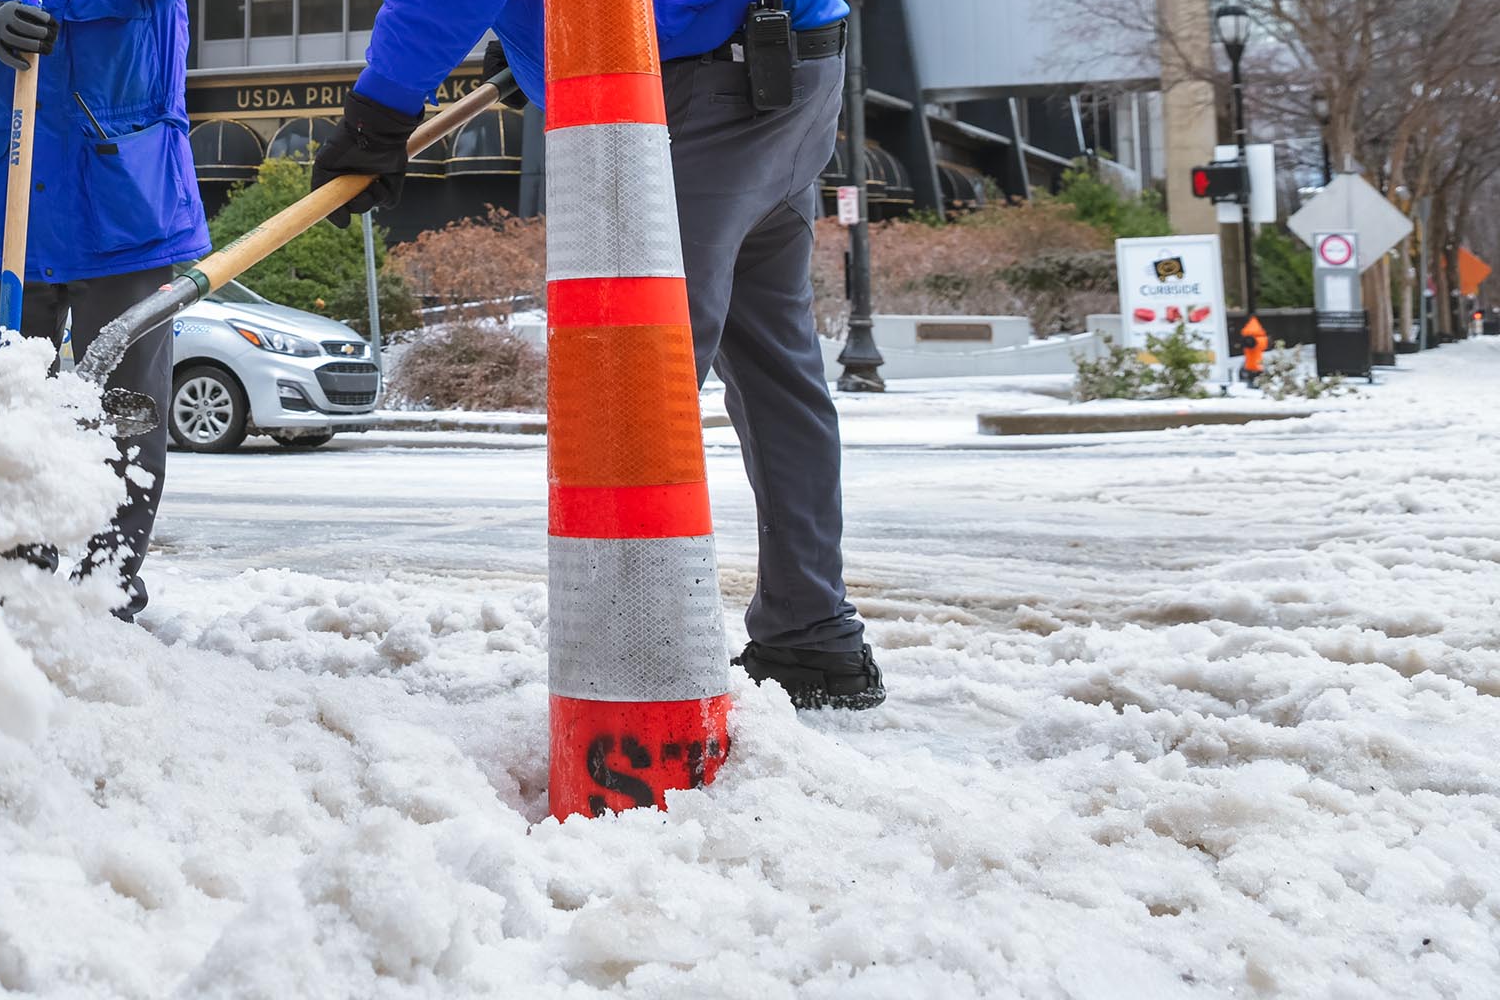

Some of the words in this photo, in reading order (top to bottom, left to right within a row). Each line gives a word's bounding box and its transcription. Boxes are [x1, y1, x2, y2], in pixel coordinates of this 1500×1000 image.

[237, 88, 296, 108] USDA
[306, 86, 349, 106] PRI
[10, 109, 23, 166] KOBALT
[1140, 283, 1202, 296] CURBSIDE
